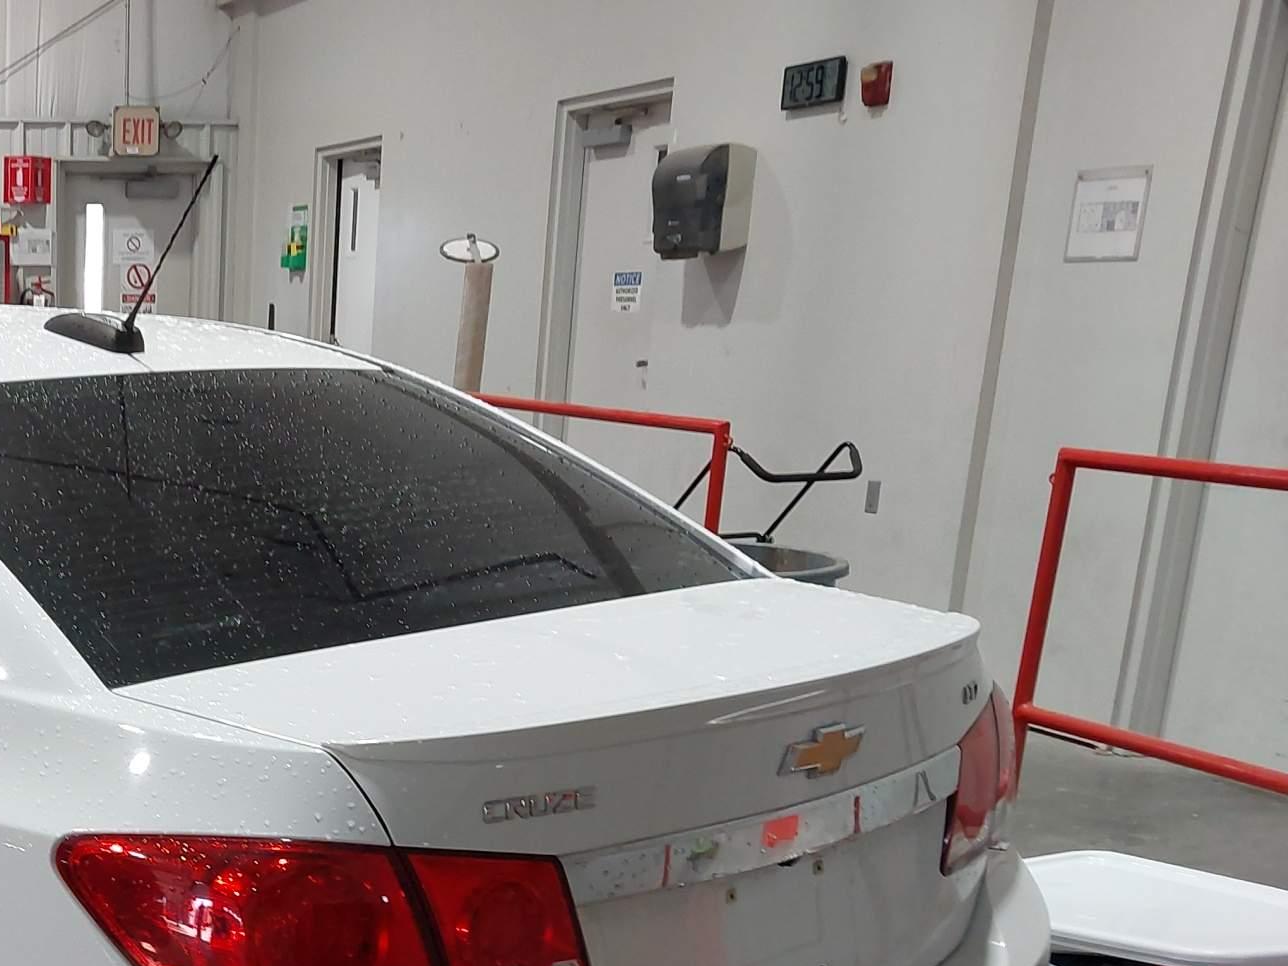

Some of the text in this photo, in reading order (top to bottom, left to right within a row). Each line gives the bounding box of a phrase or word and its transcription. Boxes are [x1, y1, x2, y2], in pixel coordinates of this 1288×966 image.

[123, 118, 154, 144] EXIT
[616, 273, 641, 285] NOTICE
[482, 786, 597, 824] CRUZE
